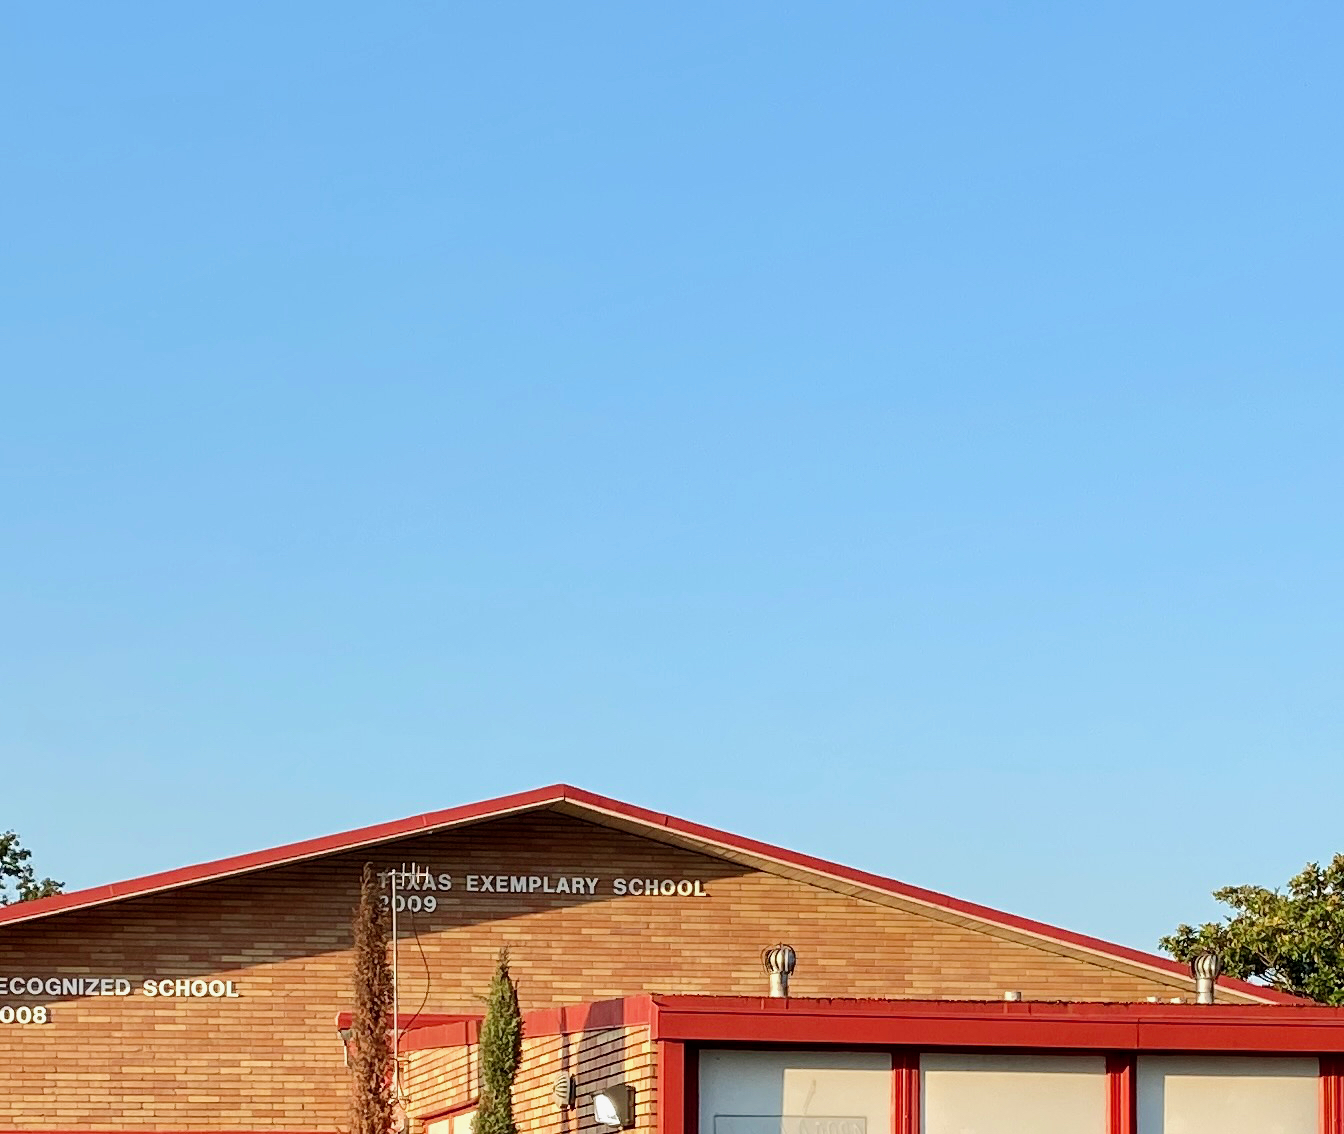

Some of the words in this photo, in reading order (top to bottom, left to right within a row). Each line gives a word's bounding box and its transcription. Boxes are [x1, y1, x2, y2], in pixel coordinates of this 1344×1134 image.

[376, 872, 452, 891] TEXAS
[466, 875, 599, 895] EXEMPLARY
[613, 878, 707, 897] SCHOOL
[378, 895, 437, 913] 2009
[143, 978, 239, 998] SCHOOL
